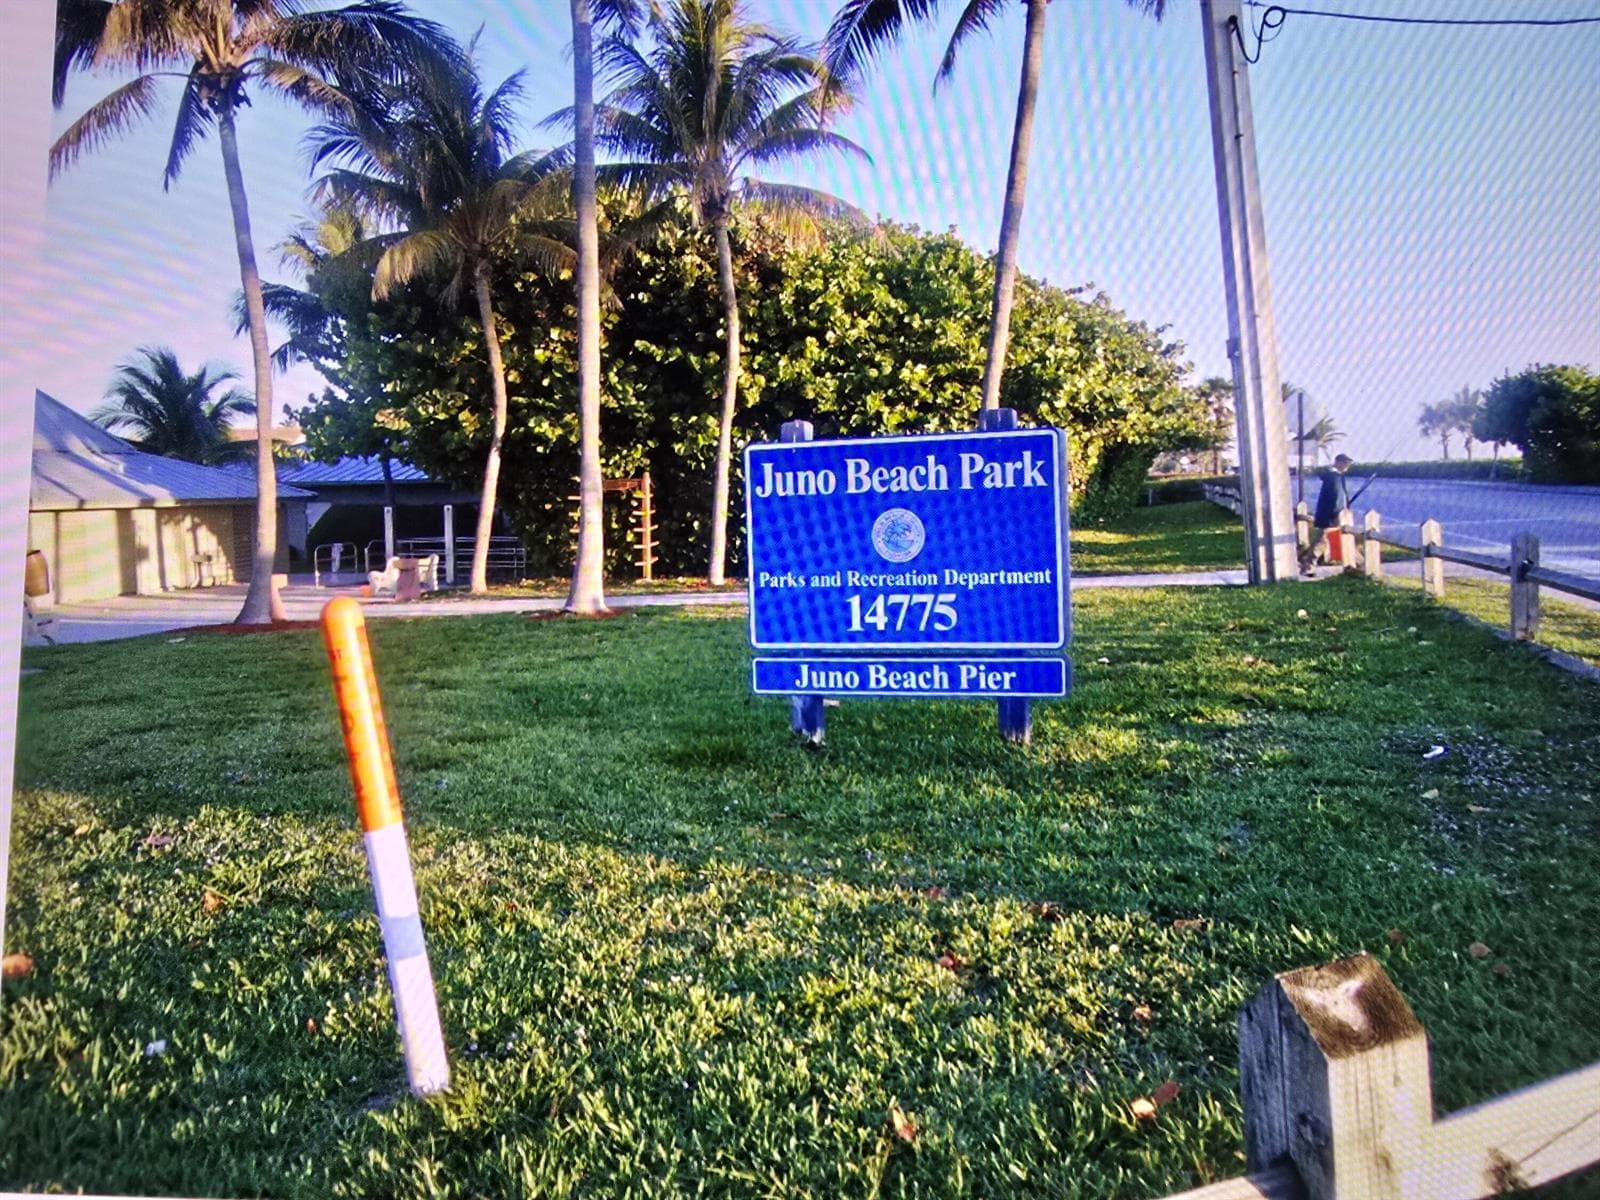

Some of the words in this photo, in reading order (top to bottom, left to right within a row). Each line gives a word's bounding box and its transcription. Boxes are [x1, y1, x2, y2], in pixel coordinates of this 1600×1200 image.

[755, 463, 836, 498] Juno
[845, 455, 948, 493] Beach
[959, 451, 1049, 490] Park
[759, 571, 806, 588] Parks
[810, 571, 841, 587] and
[847, 570, 938, 586] Recreation
[944, 568, 1051, 590] Department
[846, 593, 958, 632] 14775
[795, 665, 859, 689] Juno
[868, 664, 949, 690] Beach
[959, 664, 1017, 690] Pier
